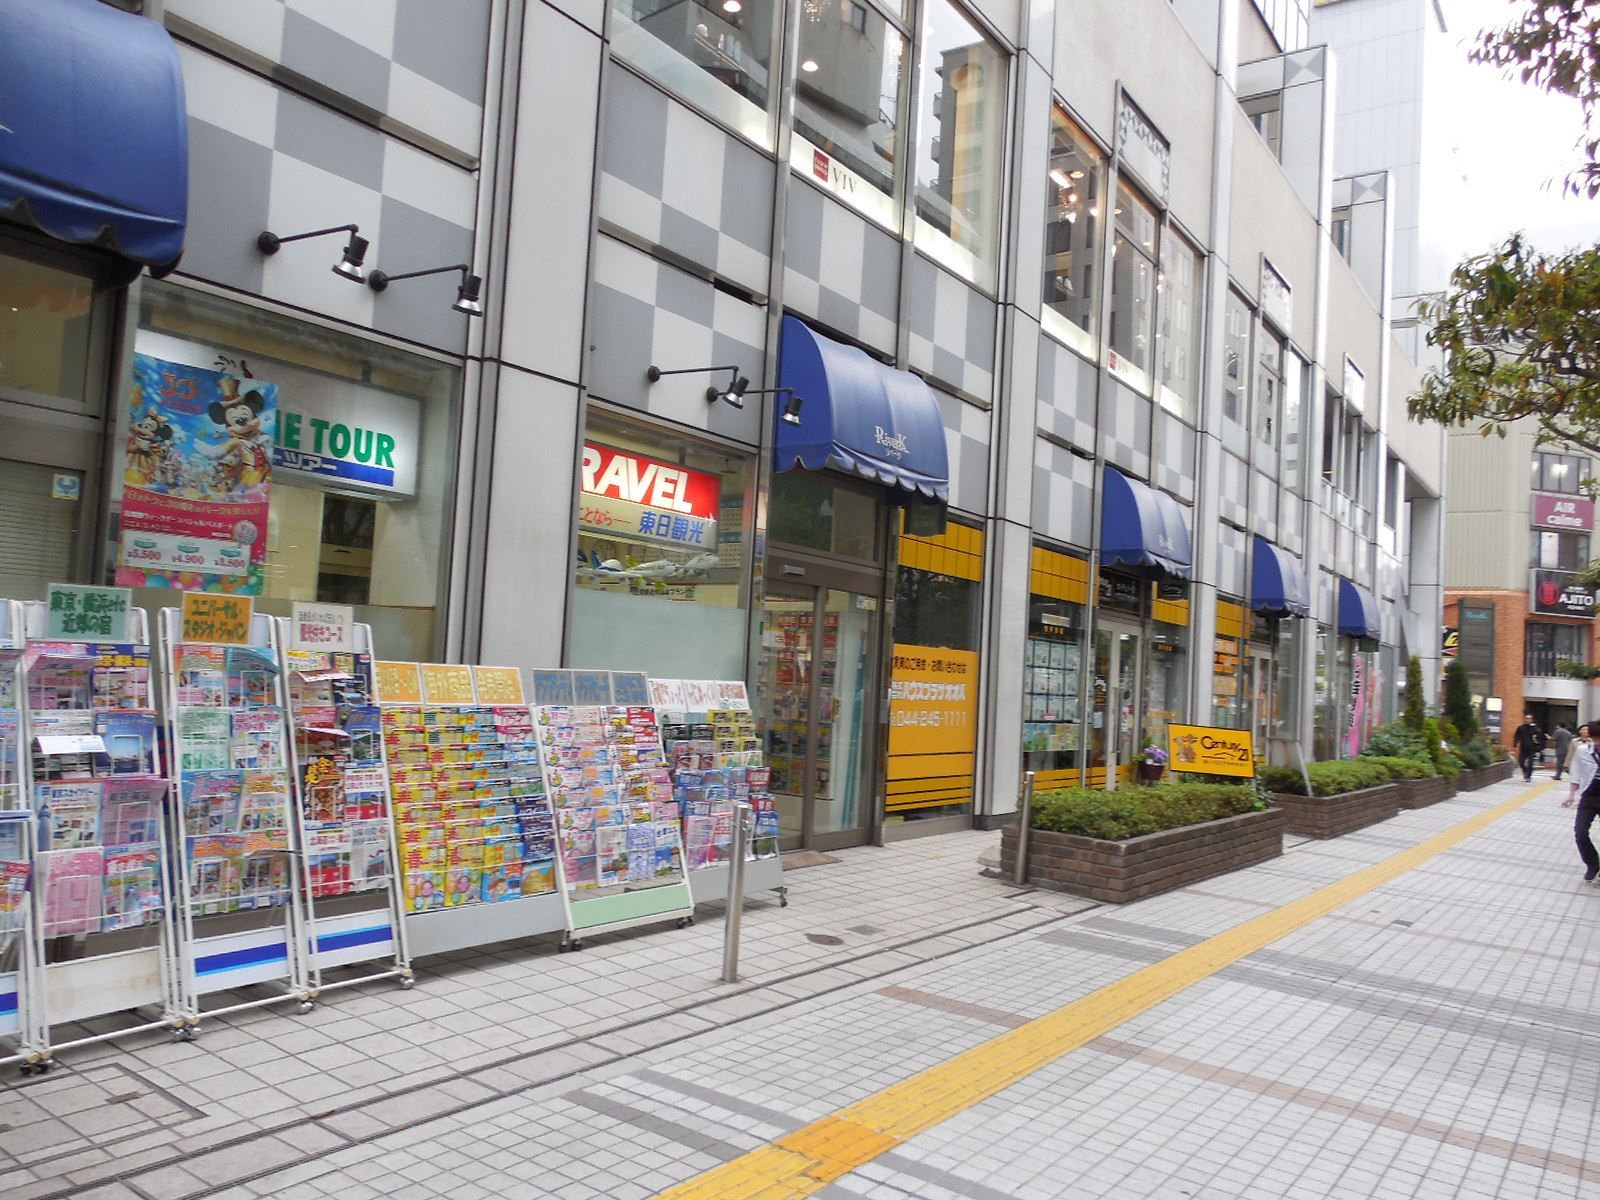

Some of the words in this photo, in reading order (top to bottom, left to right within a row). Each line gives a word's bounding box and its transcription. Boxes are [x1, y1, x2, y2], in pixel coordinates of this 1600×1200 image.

[832, 167, 858, 193] VIV
[310, 418, 396, 468] TOUR
[1553, 501, 1575, 514] AIR
[639, 511, 705, 544] 東日観光
[1558, 593, 1593, 607] AJITO
[1201, 735, 1241, 752] Century
